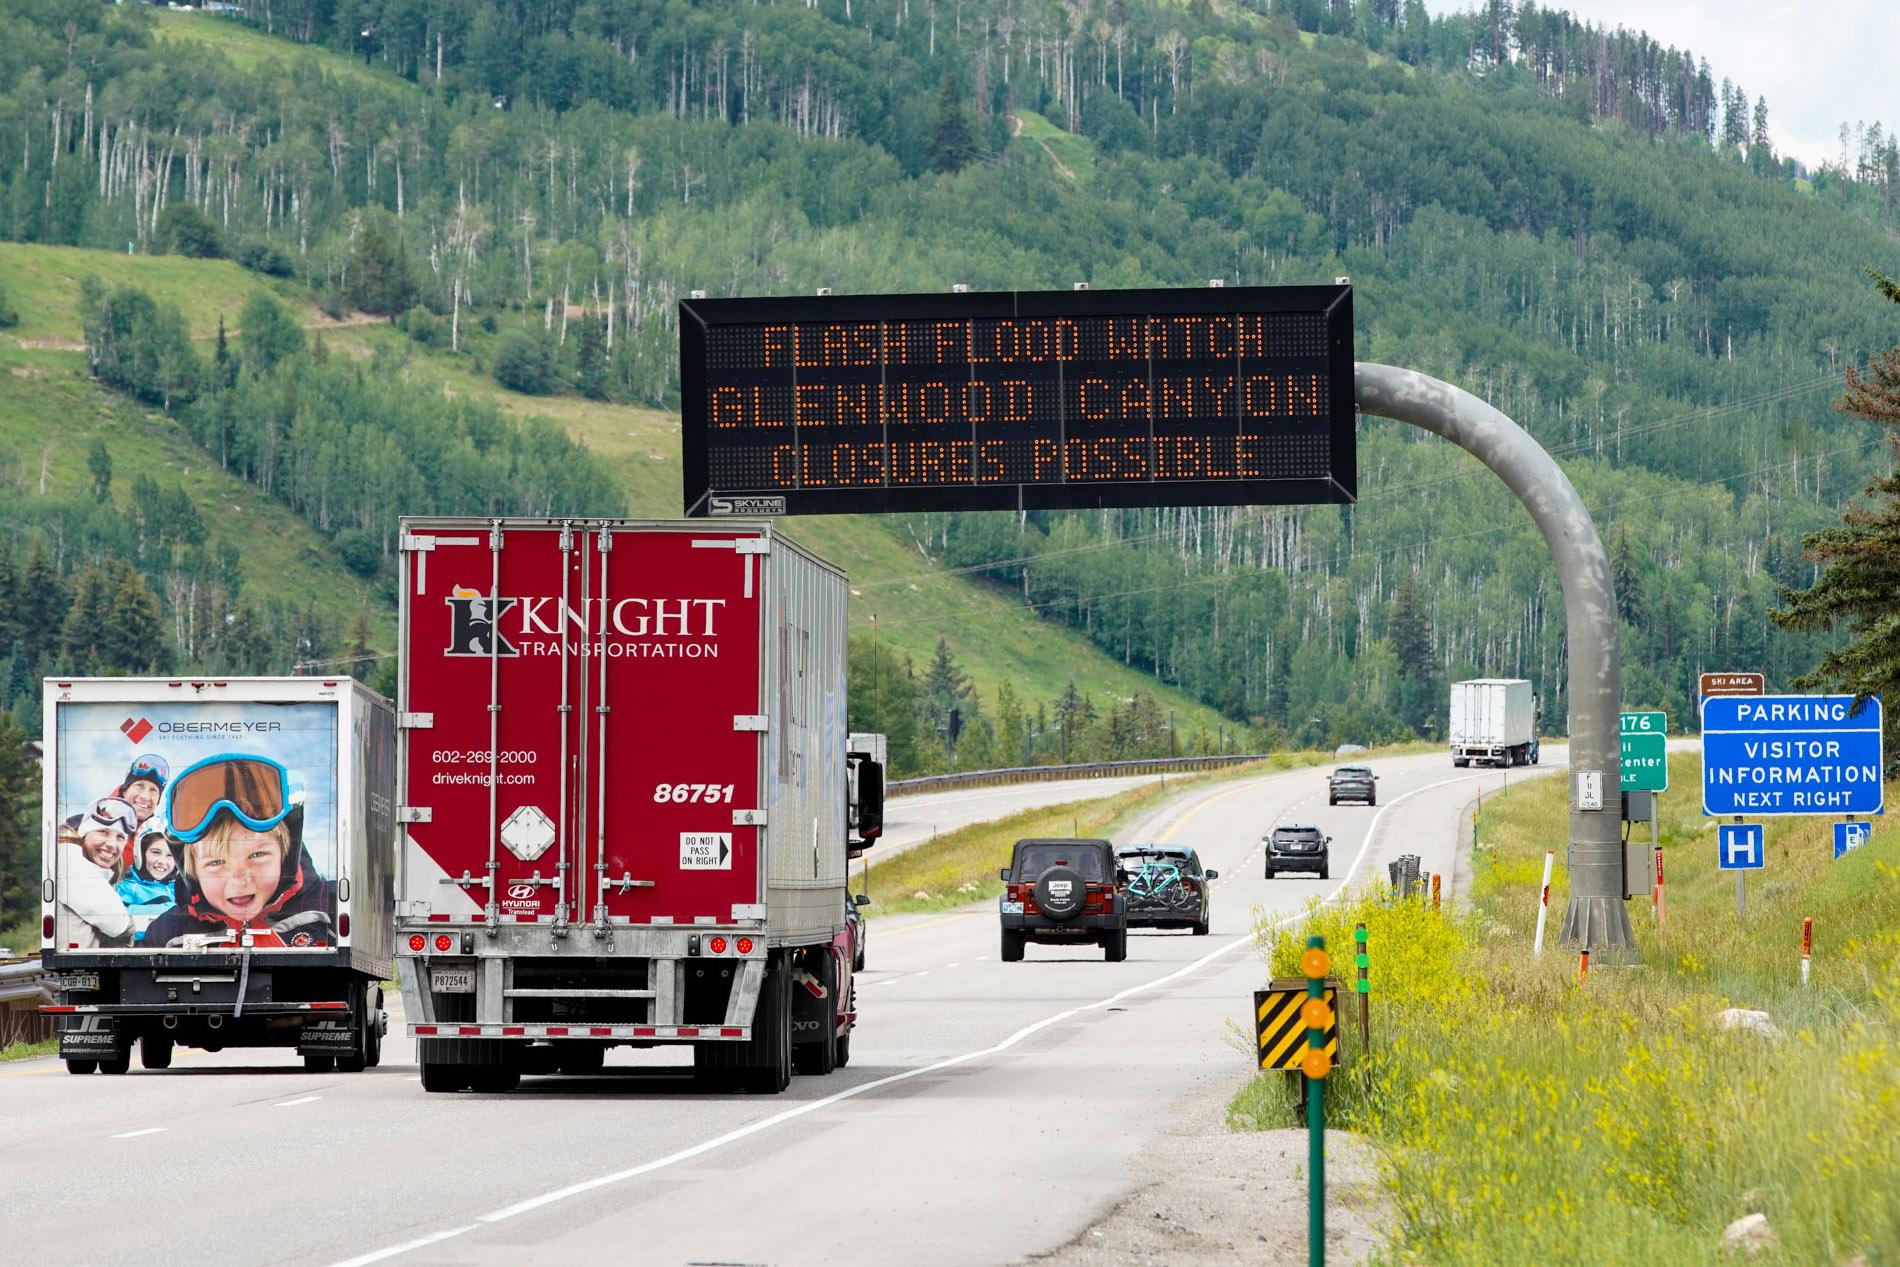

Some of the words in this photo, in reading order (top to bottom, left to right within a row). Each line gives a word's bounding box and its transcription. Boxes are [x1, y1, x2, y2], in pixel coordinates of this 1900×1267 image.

[763, 323, 907, 368] FLASH
[935, 320, 1080, 364] FLOOD
[1108, 316, 1264, 360] WATCH
[712, 380, 1034, 428] GLENWOOD
[1080, 374, 1319, 420] CANYON
[772, 439, 1005, 486] CLOSURES
[1033, 435, 1260, 480] POSSIBLE
[519, 641, 719, 658] TRANSPORTATION
[1729, 677, 1753, 685] AREA
[1737, 703, 1846, 722] PARKING
[158, 722, 281, 732] OBERMEYER
[1620, 716, 1651, 730] 176
[432, 750, 537, 764] 602-269-2000
[1744, 741, 1840, 759] VISITOR
[1620, 757, 1661, 768] enter
[1709, 766, 1877, 784] INFORMATION
[653, 783, 735, 804] 86751
[1733, 793, 1783, 807] NEXT
[1793, 791, 1852, 806] RIGHT
[685, 837, 696, 845] DO
[699, 837, 714, 845] NOT
[1727, 831, 1755, 863] H
[690, 847, 709, 855] PASS
[682, 856, 693, 865] ON
[696, 856, 718, 865] RIGHT
[502, 900, 540, 908] HYUNDAI
[434, 975, 468, 986] P872544
[62, 1035, 115, 1044] SUPREME
[301, 1032, 352, 1040] SUPREME
